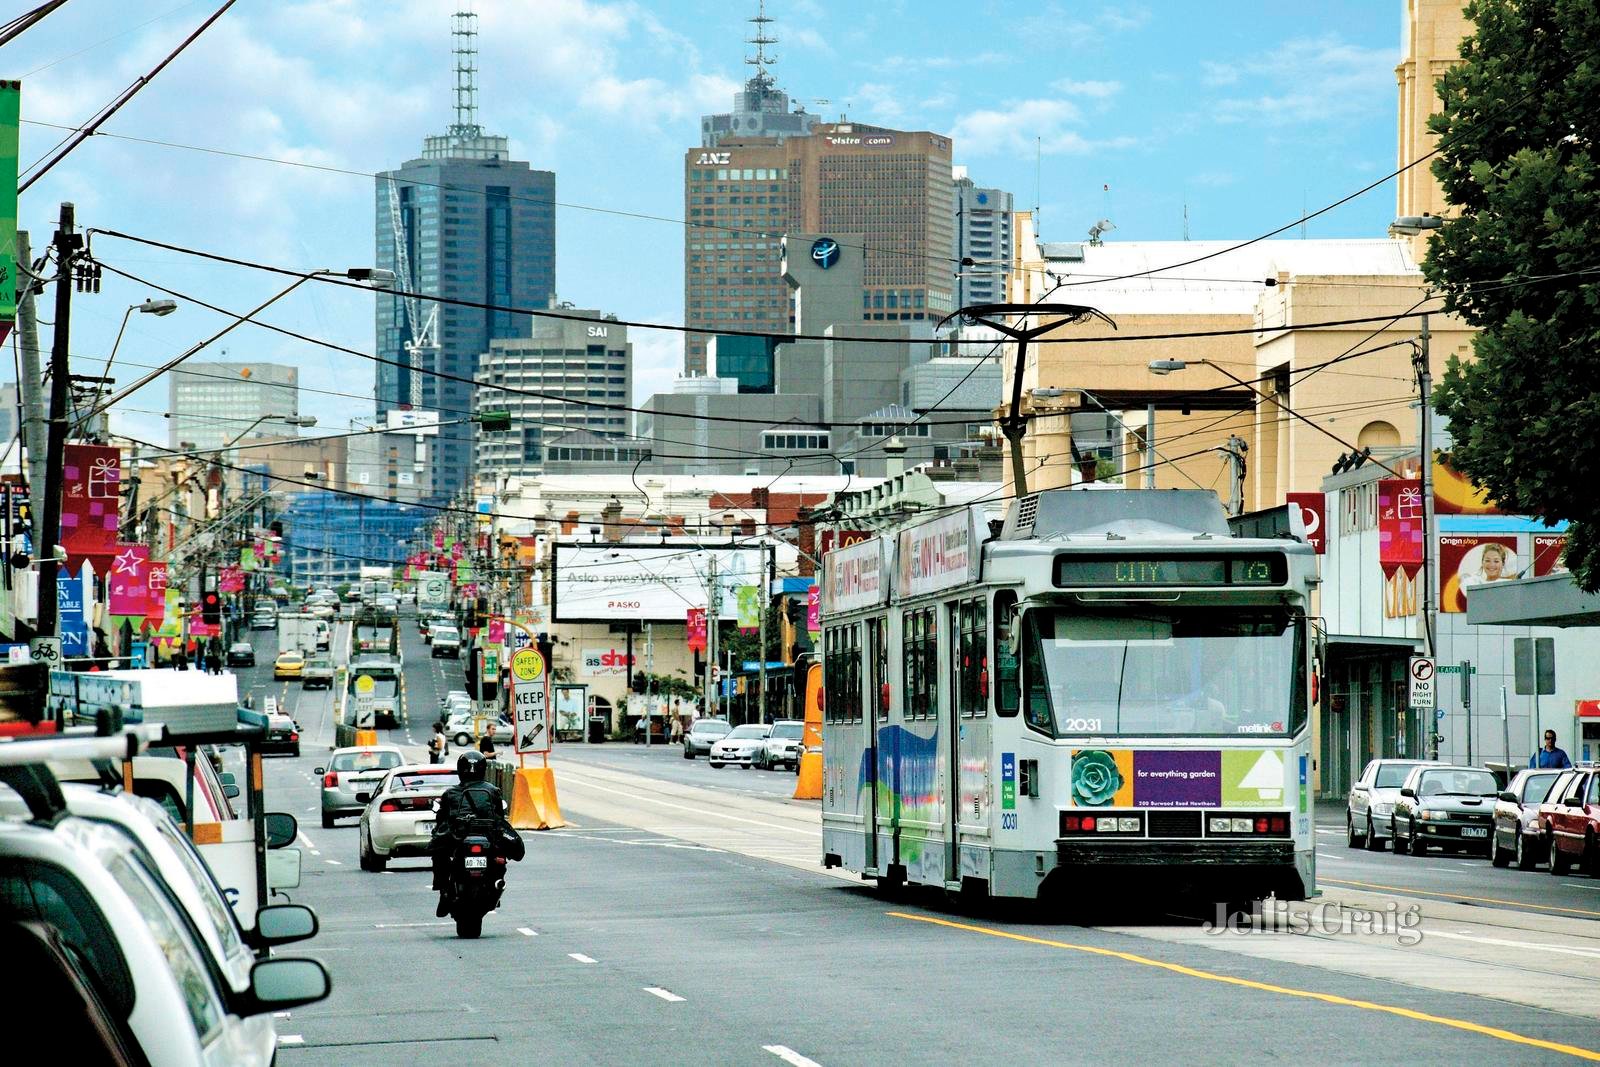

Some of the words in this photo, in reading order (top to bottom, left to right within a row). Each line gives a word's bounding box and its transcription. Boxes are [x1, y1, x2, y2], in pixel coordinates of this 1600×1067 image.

[696, 152, 731, 165] ANZ
[587, 326, 608, 337] SAI
[1307, 539, 1320, 547] ST
[1115, 562, 1160, 582] CITY
[1248, 563, 1269, 579] 75
[567, 572, 599, 583] Asko
[603, 575, 636, 584] saves
[616, 601, 641, 609] ASKO
[515, 656, 539, 667] SAFETY
[520, 667, 536, 677] ZONE
[1415, 682, 1430, 691] NO
[515, 691, 544, 705] KEEP
[517, 708, 544, 722] LEFT
[1065, 718, 1102, 731] 2031
[1238, 723, 1272, 733] metlink
[1137, 769, 1149, 778] for
[1150, 770, 1188, 779] everything
[1189, 770, 1216, 779] garden
[1002, 813, 1018, 830] 2031
